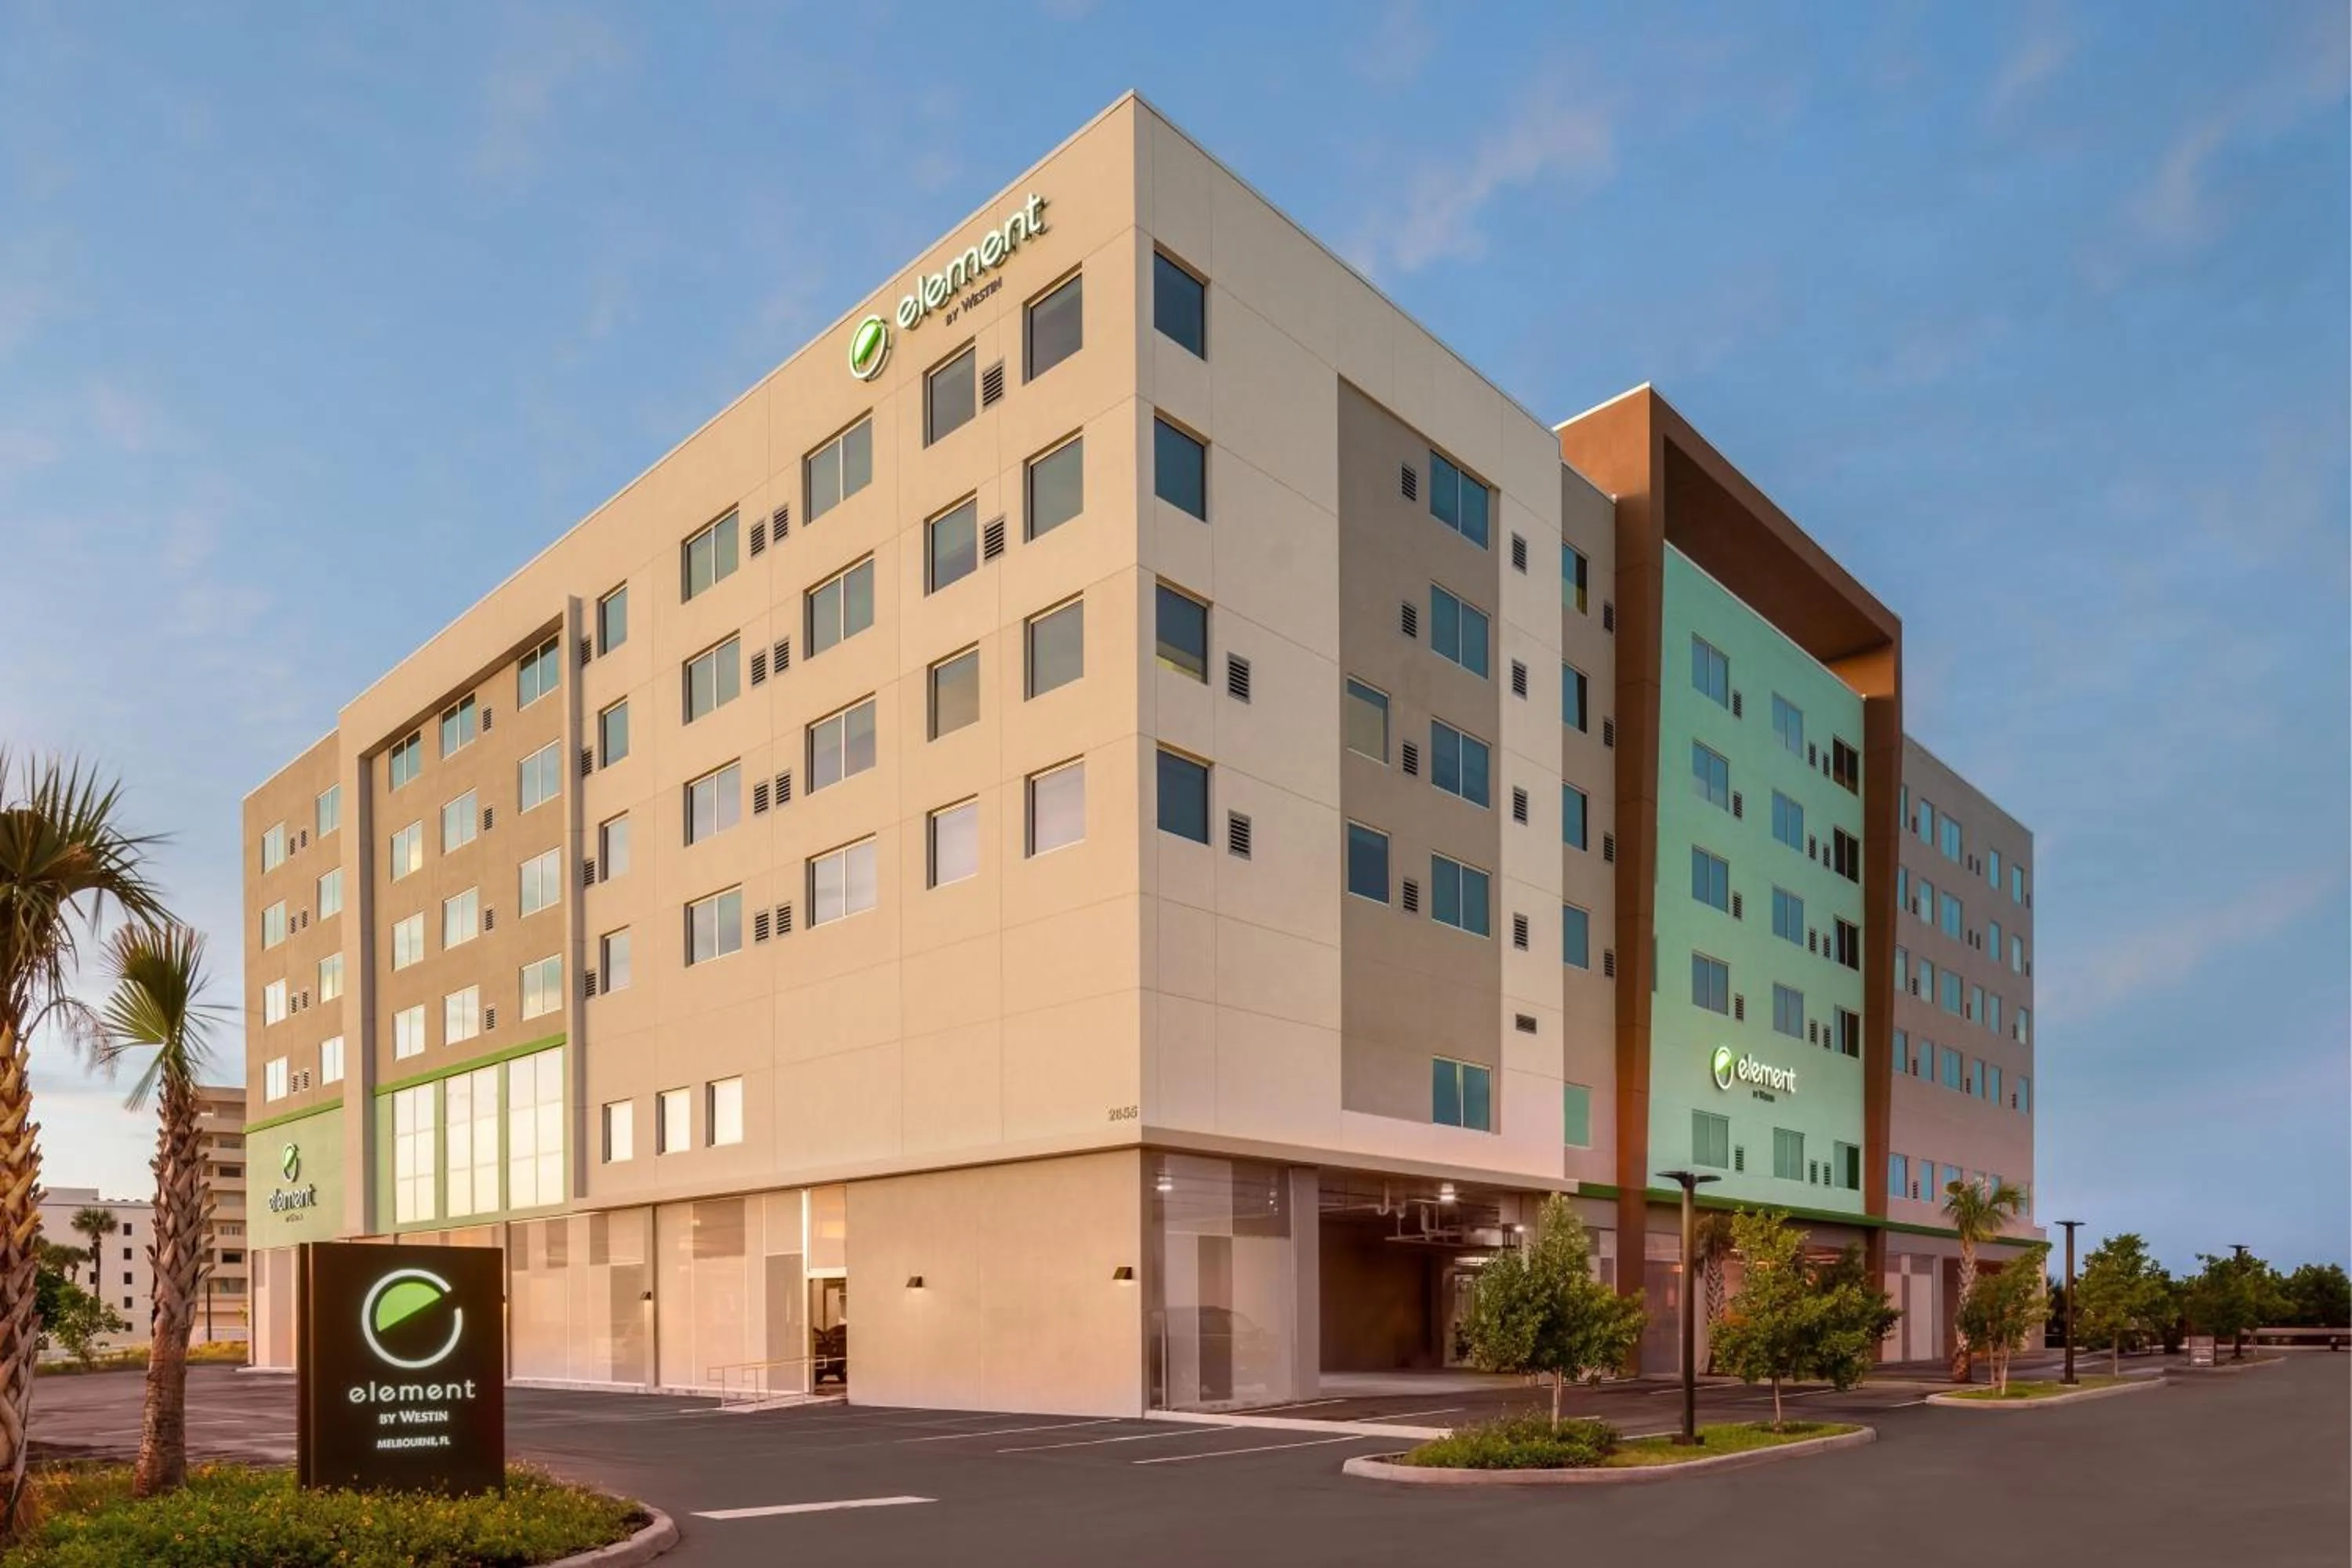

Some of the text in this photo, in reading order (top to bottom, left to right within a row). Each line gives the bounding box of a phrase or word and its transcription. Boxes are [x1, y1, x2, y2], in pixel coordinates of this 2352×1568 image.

[897, 193, 1047, 329] element
[946, 307, 959, 327] BY
[1737, 1053, 1797, 1094] element
[269, 1183, 317, 1213] element
[349, 1379, 476, 1403] element
[378, 1410, 448, 1425] BY WESTIN
[376, 1436, 451, 1450] MELBOURNE, FL
